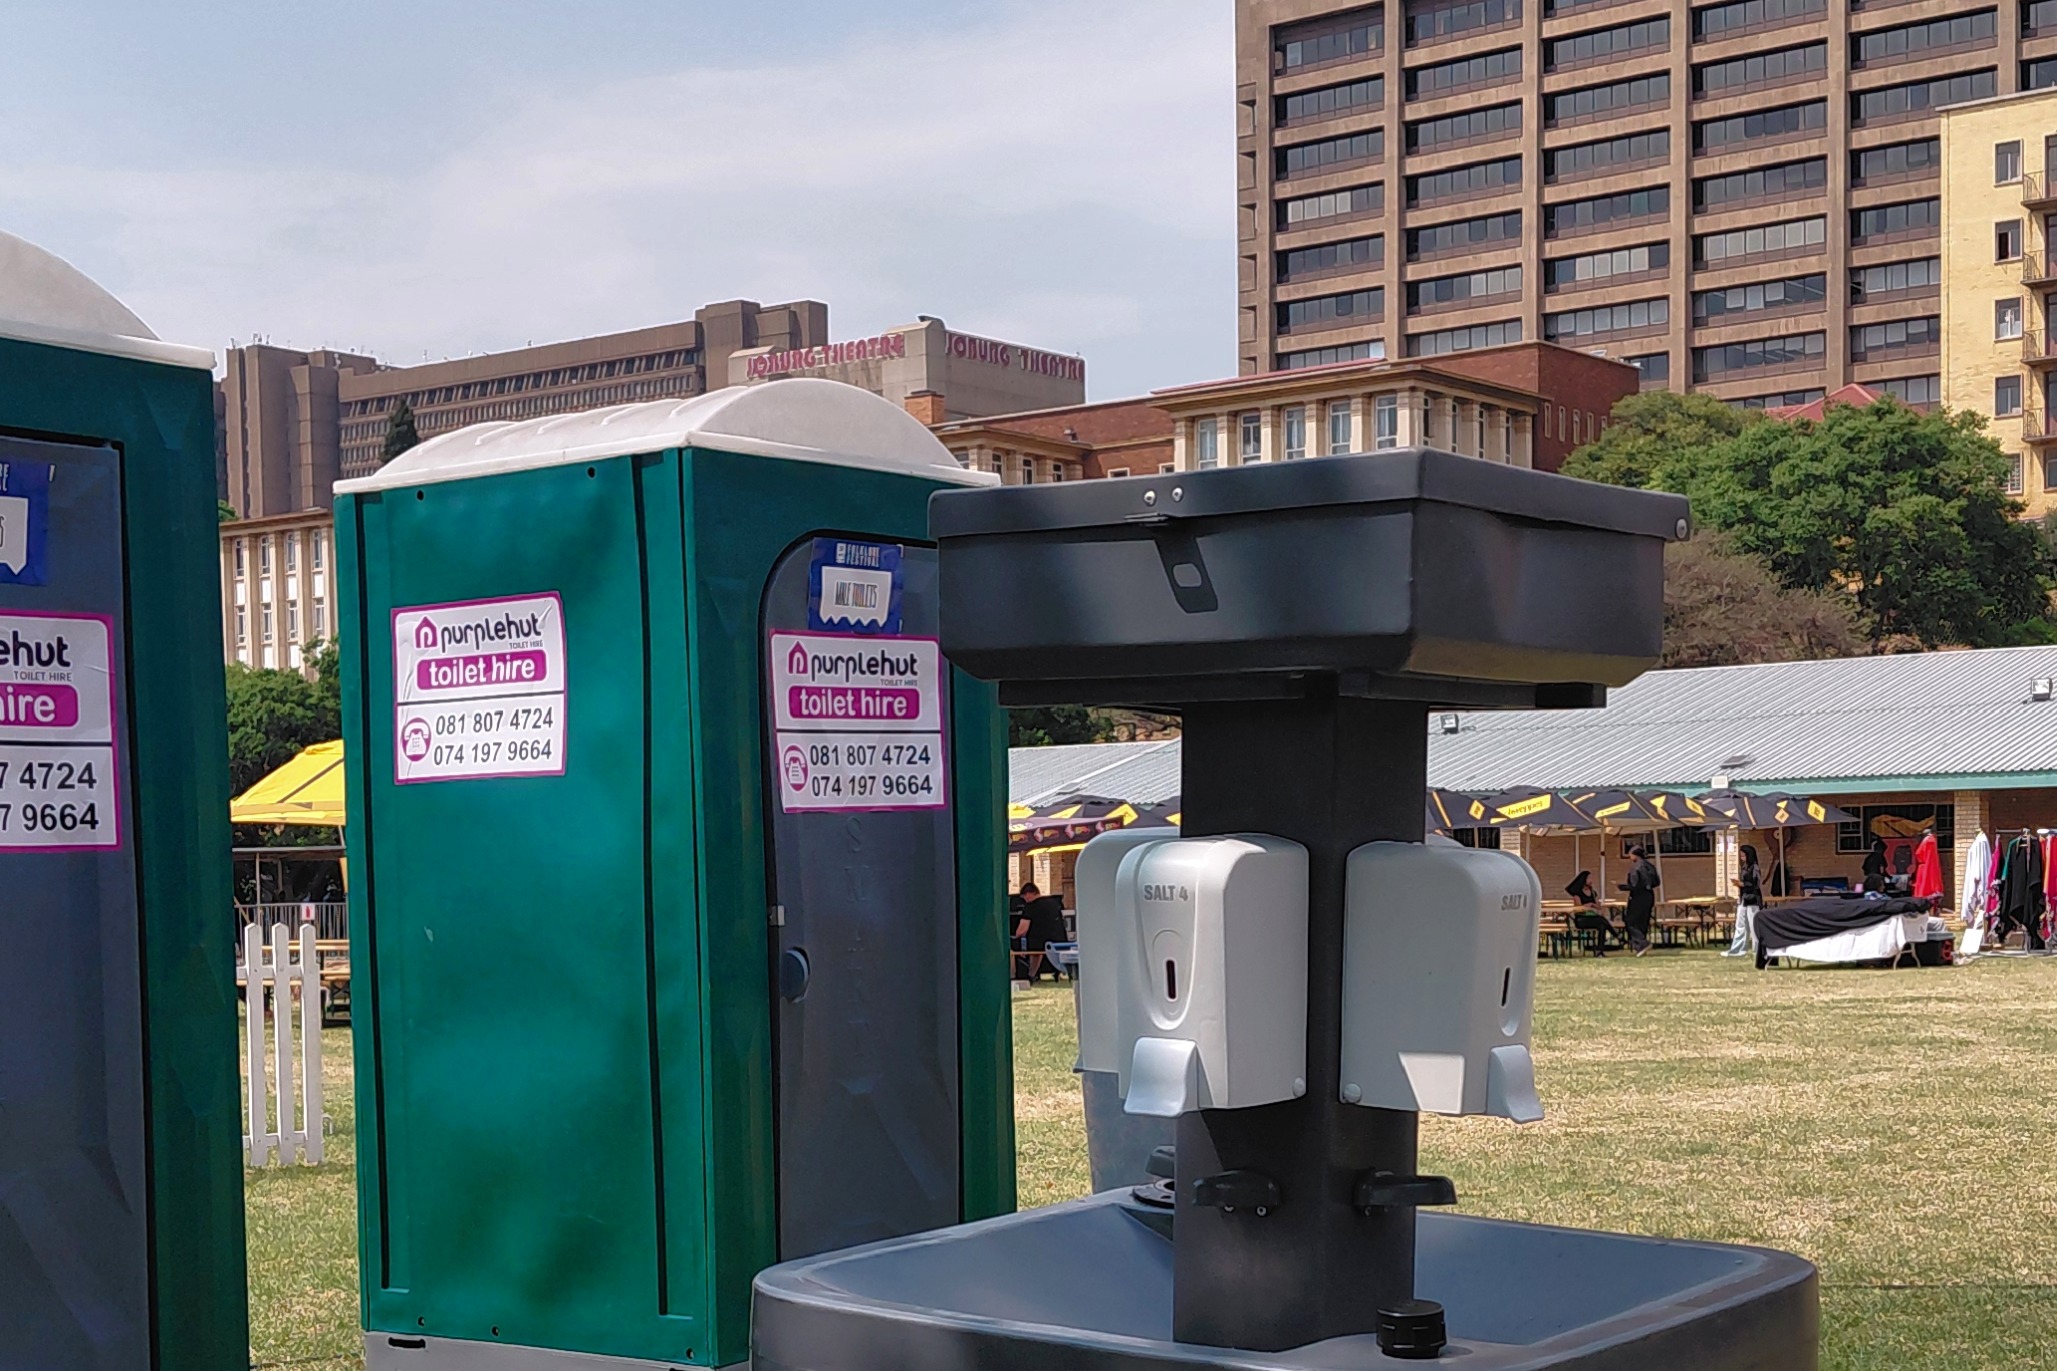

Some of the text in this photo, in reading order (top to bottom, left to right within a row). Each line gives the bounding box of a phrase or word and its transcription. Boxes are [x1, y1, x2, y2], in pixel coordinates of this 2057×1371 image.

[747, 333, 905, 377] JOBURG THEATRE
[945, 332, 1010, 366] JOBURG
[441, 613, 541, 653] purplehut
[509, 642, 529, 650] TOILET
[13, 670, 73, 682] TOILET HIRE
[429, 655, 536, 686] toilet hire
[811, 649, 918, 682] purplehut
[0, 685, 55, 722] ire
[800, 688, 907, 717] toilet hire
[435, 707, 553, 735] 081 807 4724
[434, 739, 552, 765] 074 197 9664
[810, 744, 931, 766] 081 807 4724
[20, 761, 97, 789] 4724
[812, 774, 933, 797] 074 197 9664
[22, 803, 99, 831] 9664
[1144, 884, 1189, 902] SALT 4
